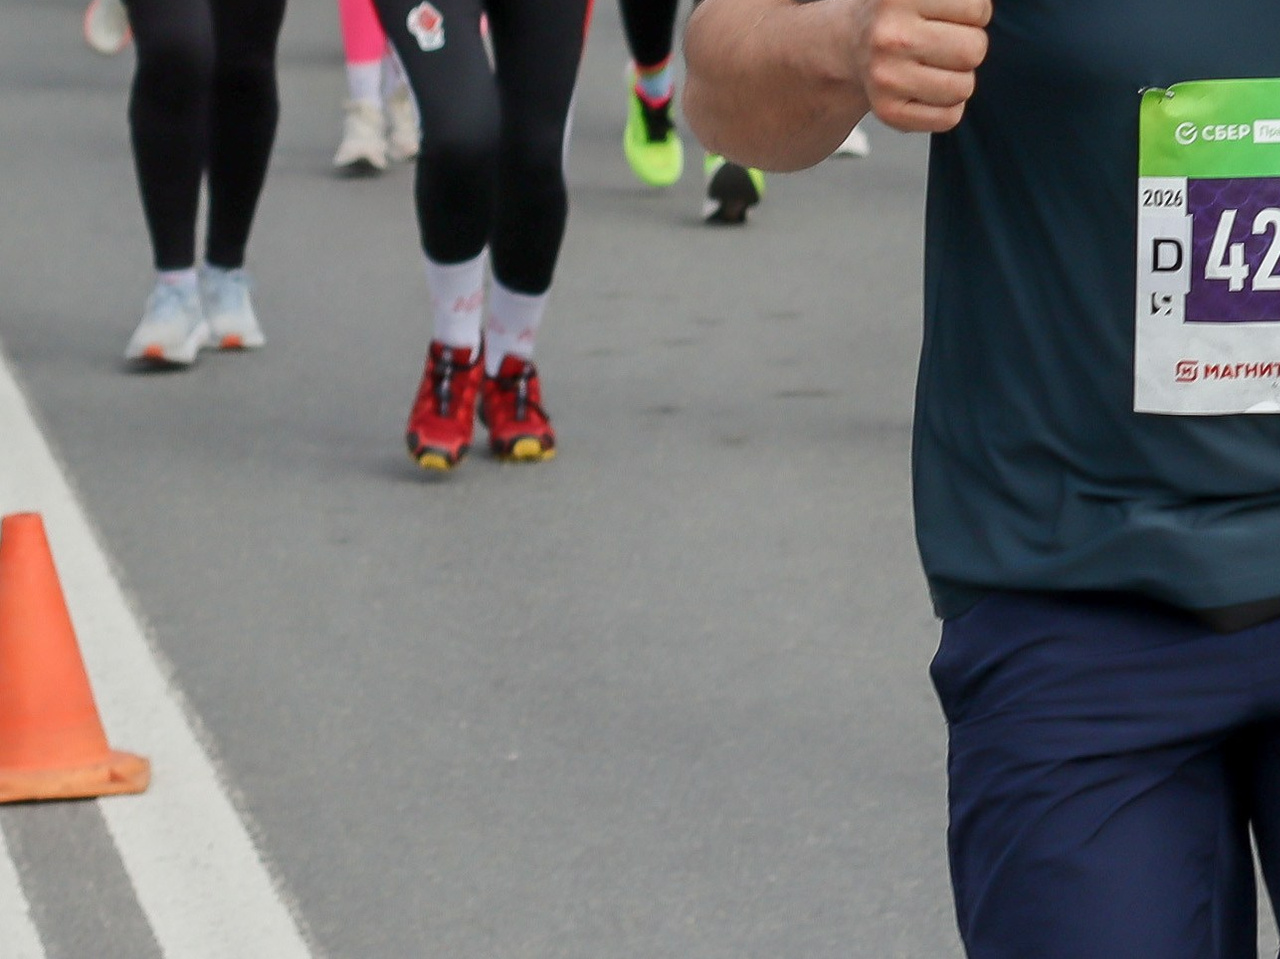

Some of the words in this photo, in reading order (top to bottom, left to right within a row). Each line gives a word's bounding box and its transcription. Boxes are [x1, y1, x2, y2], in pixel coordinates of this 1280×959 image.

[1201, 123, 1251, 141] СБЕР
[1142, 189, 1183, 207] 2026
[1151, 238, 1183, 273] D
